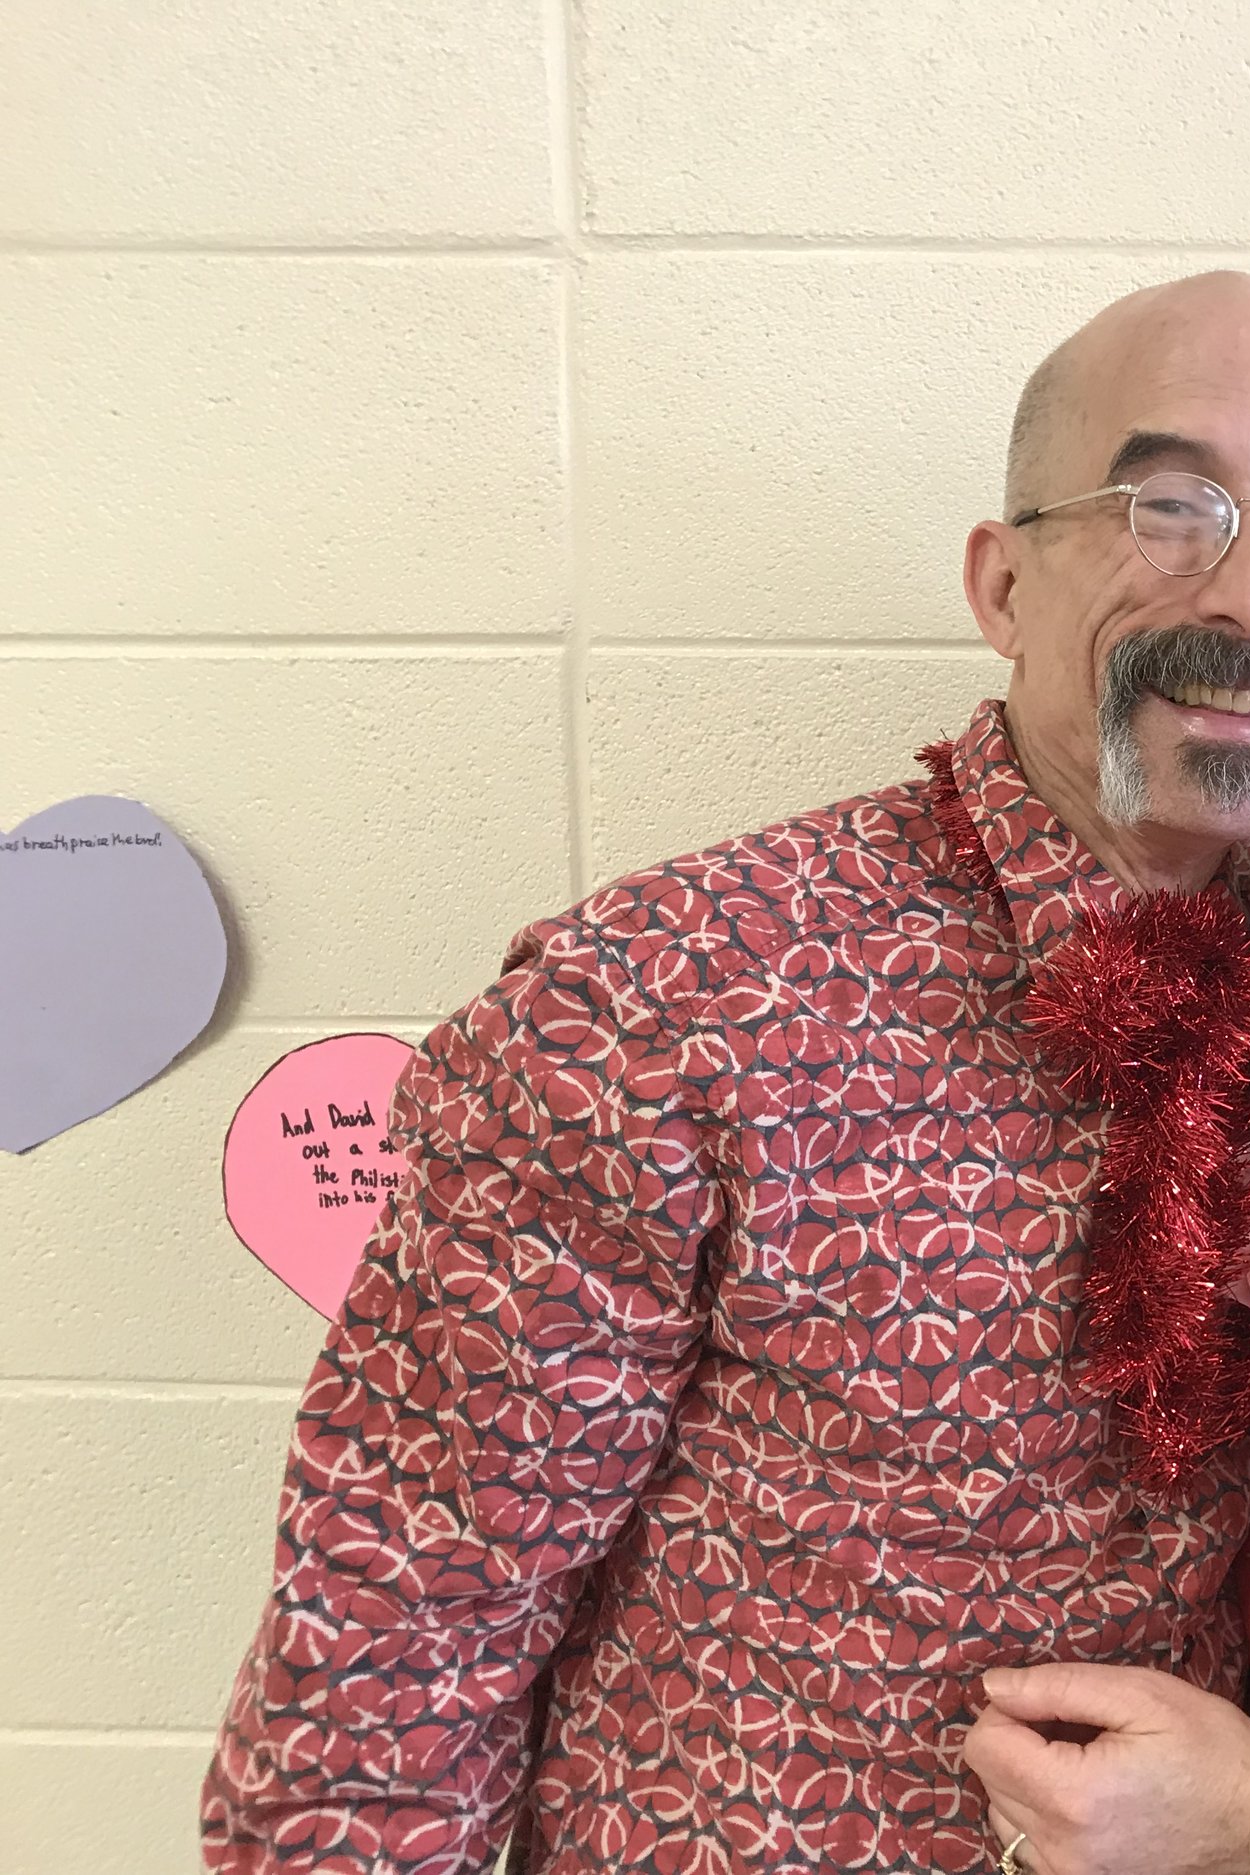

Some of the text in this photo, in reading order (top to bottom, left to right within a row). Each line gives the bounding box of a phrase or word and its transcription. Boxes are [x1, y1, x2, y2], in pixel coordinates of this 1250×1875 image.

[22, 834, 69, 851] breath
[70, 834, 109, 854] praise
[111, 832, 133, 846] the
[280, 1100, 375, 1138] And David
[302, 1141, 330, 1159] out
[349, 1143, 363, 1155] a
[313, 1164, 404, 1188] the Philist
[318, 1190, 349, 1208] into
[354, 1190, 376, 1204] his
